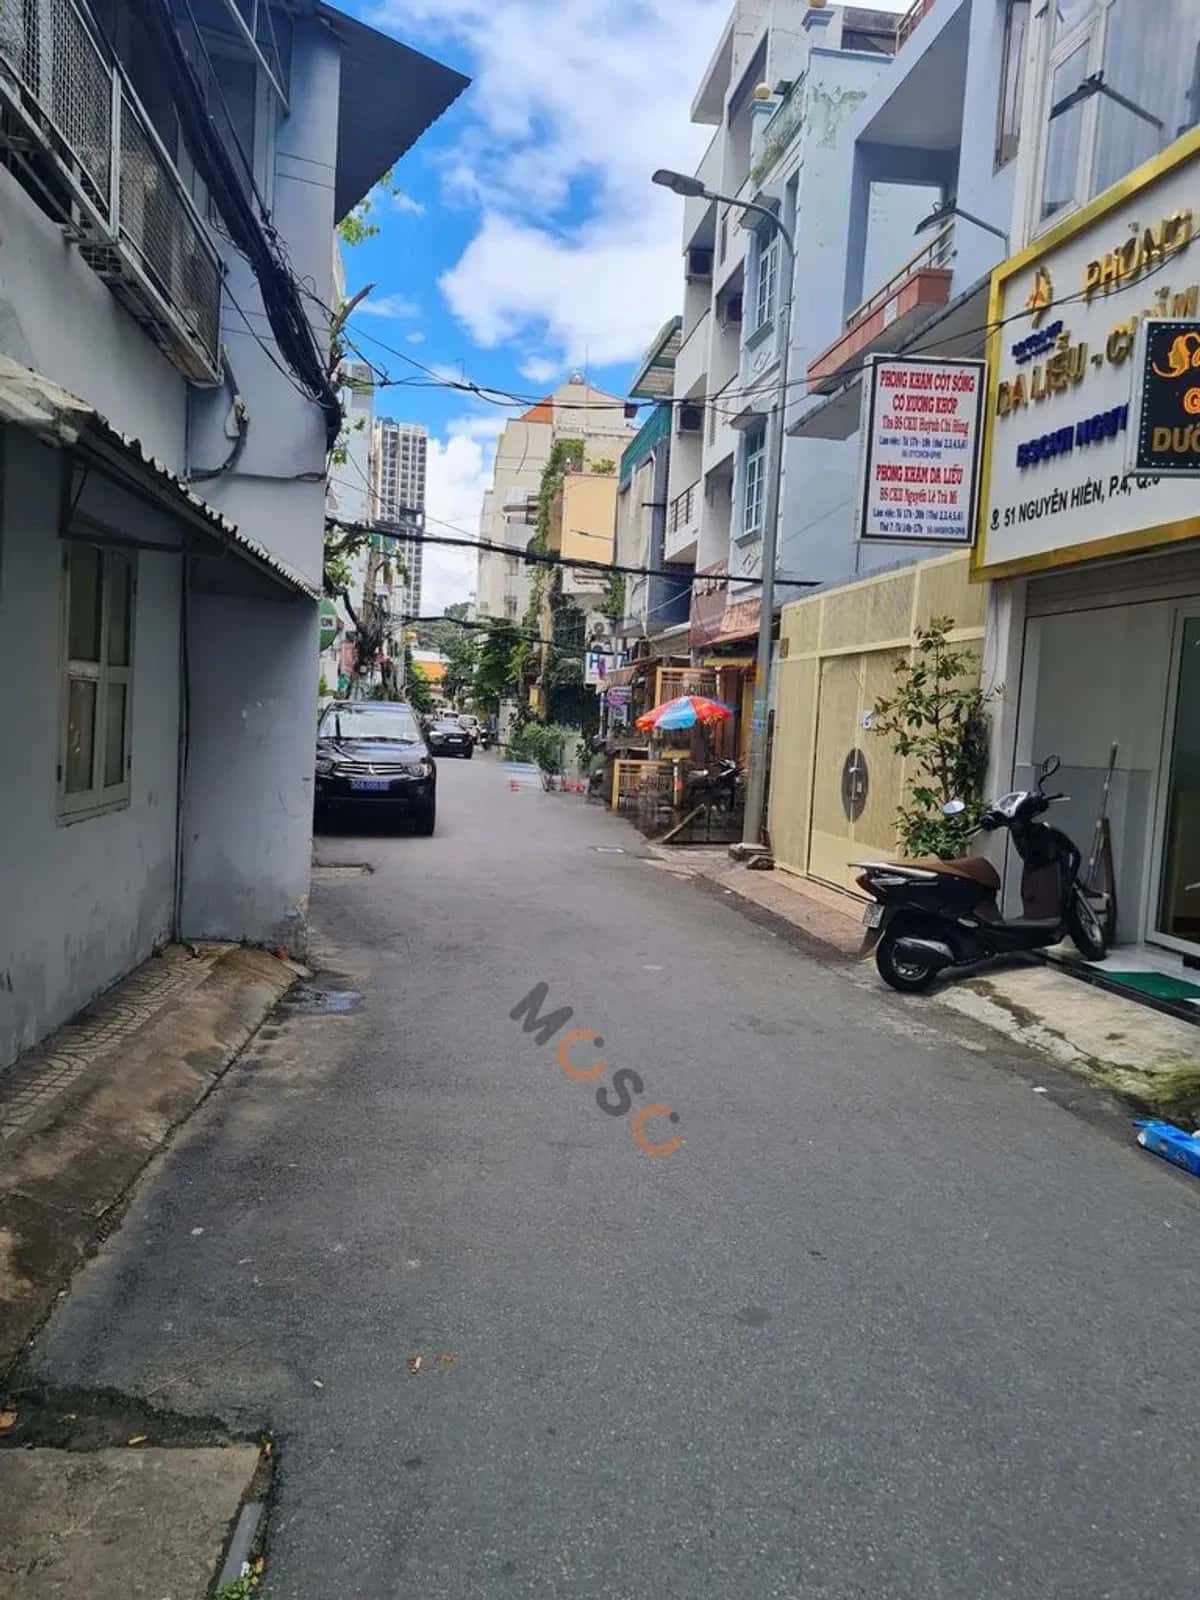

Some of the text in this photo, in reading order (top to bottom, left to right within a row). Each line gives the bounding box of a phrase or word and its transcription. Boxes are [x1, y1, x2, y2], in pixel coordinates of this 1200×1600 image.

[996, 373, 1028, 416] DA
[1004, 508, 1016, 527] 51
[1018, 487, 1069, 523] NGUYỄN
